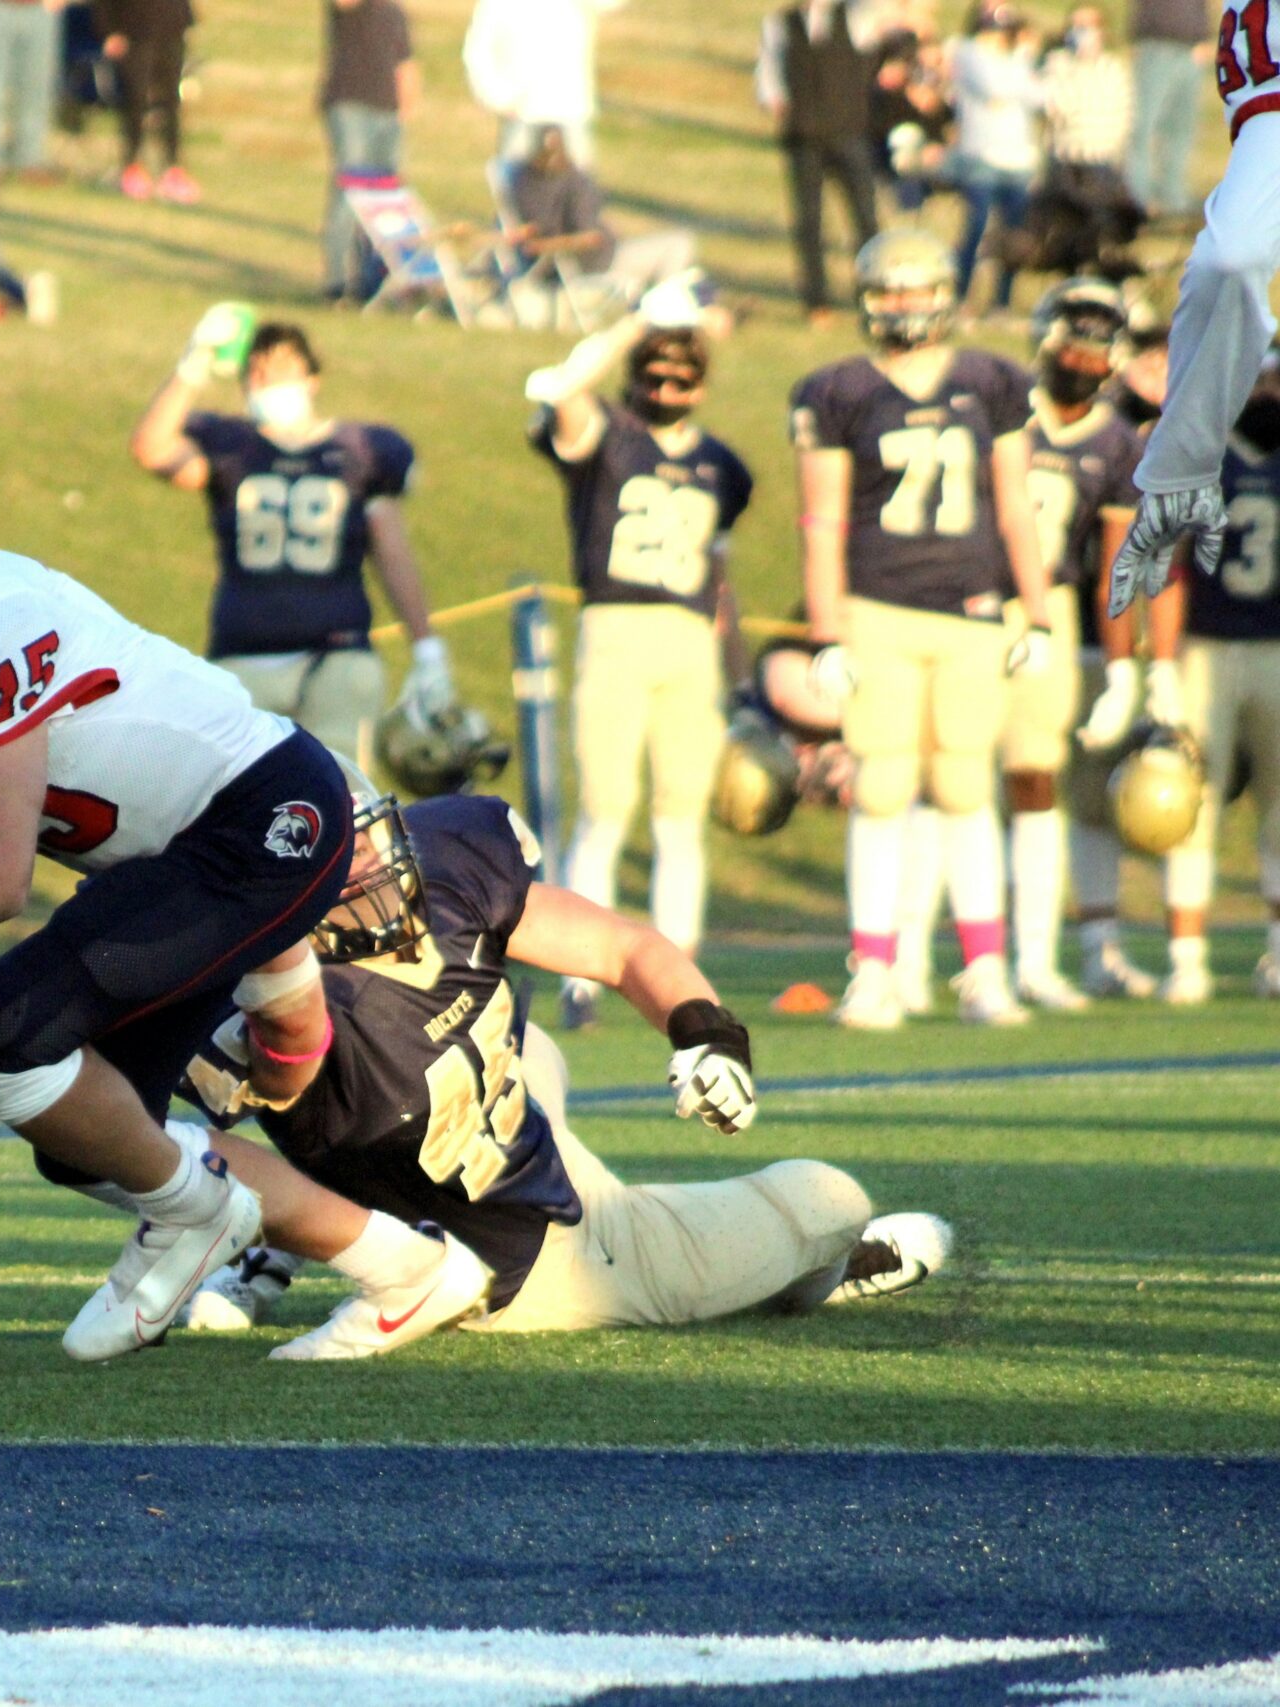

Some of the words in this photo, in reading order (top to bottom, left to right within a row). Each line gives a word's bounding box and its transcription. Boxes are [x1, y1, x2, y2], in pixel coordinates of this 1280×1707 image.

[236, 474, 350, 574] 69
[878, 426, 976, 536] 71
[423, 990, 475, 1042] ROCKETS
